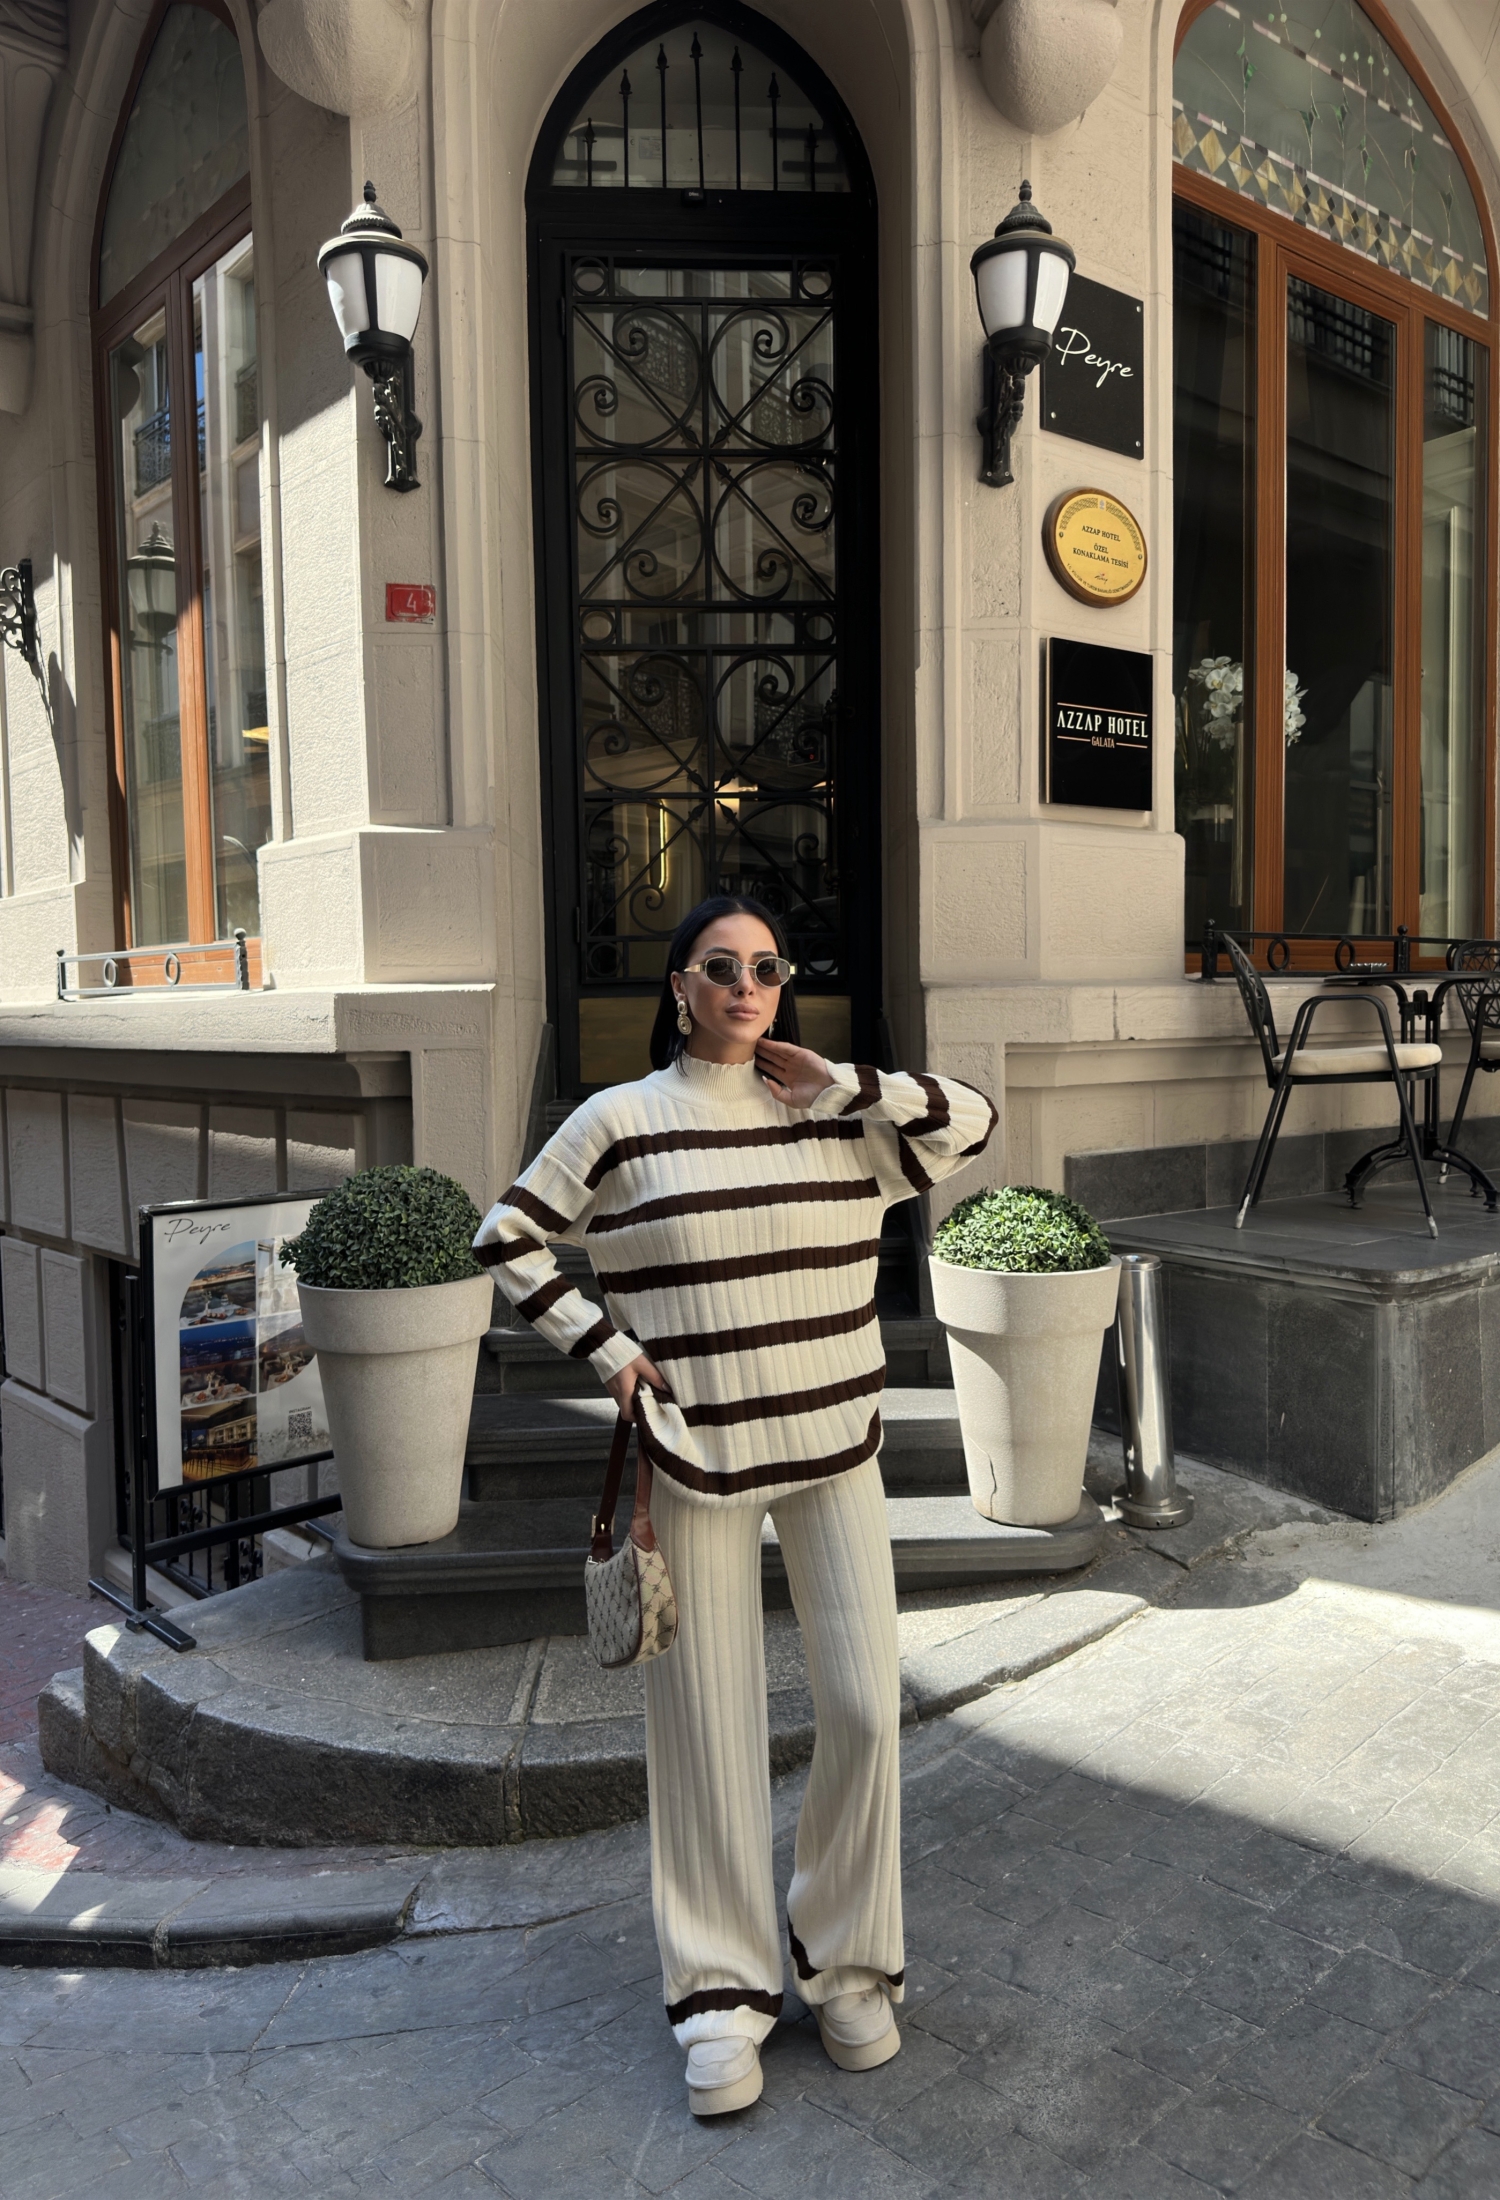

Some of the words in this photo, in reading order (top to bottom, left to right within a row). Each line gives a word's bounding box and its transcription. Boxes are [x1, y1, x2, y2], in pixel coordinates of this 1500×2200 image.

[1055, 327, 1134, 389] Peyre
[1082, 525, 1100, 536] AZZAP
[1102, 530, 1121, 542] HOTEL
[1072, 547, 1110, 564] KONAKLAMA
[1093, 543, 1109, 554] ÖZEL
[406, 592, 417, 612] 4
[1057, 710, 1102, 732] AZZAP
[1108, 716, 1149, 738] HOTEL
[1091, 736, 1115, 749] GALATA
[164, 1218, 231, 1245] Peyre
